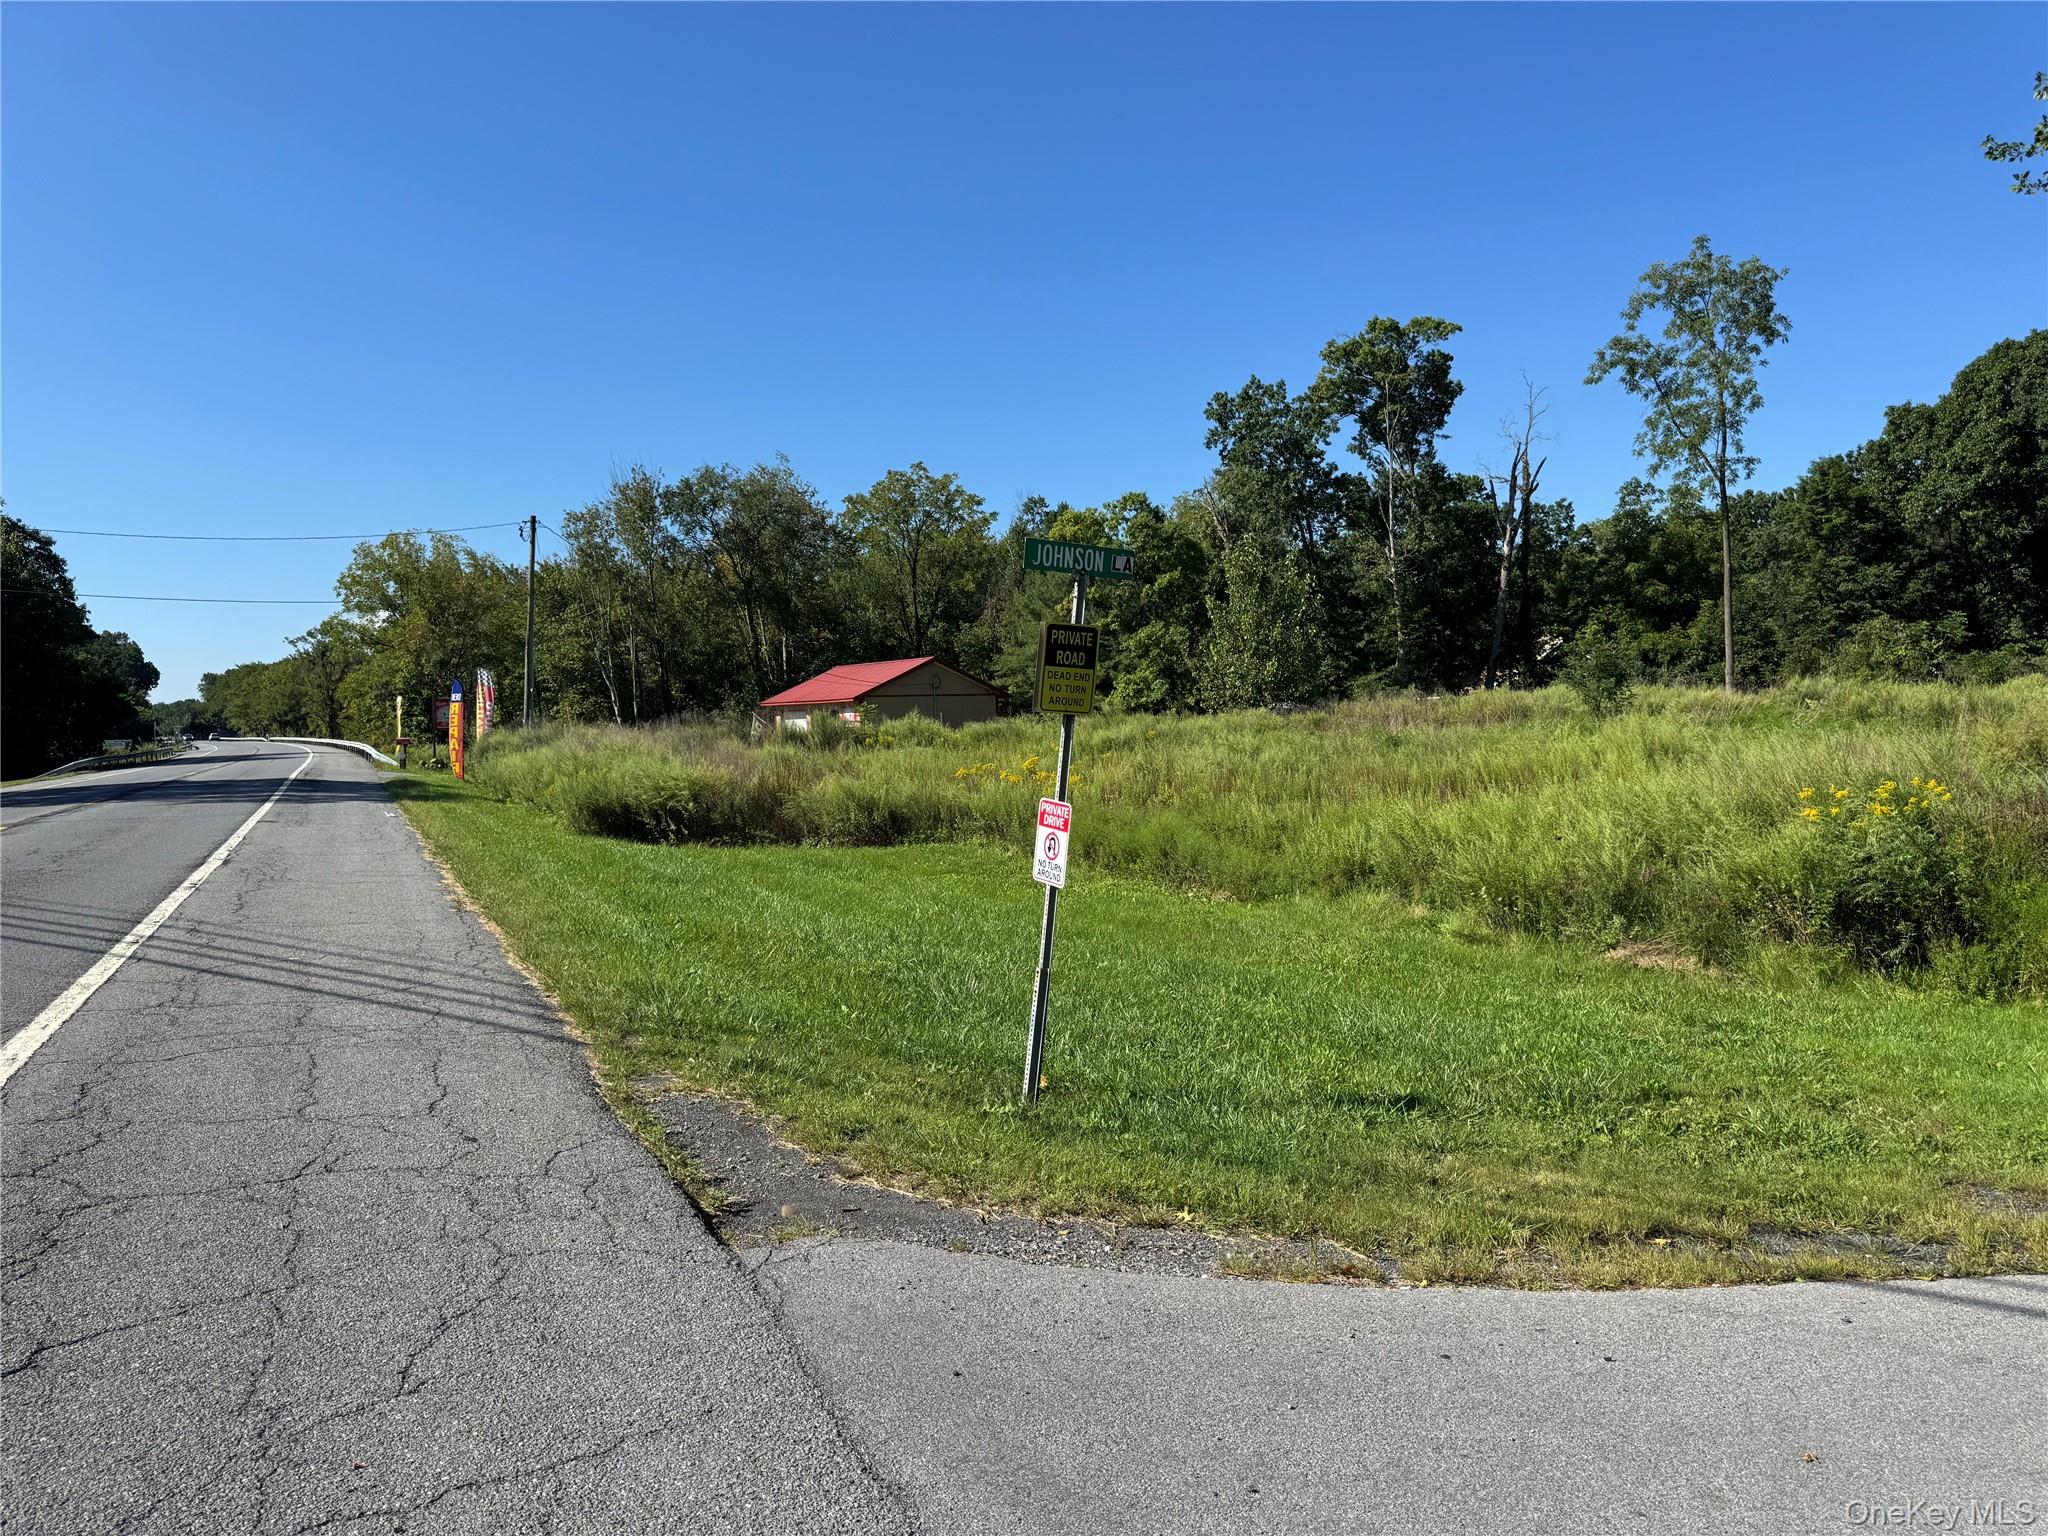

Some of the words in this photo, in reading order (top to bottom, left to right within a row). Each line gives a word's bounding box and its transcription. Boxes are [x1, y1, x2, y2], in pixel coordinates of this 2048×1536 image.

[1032, 544, 1105, 572] JOHNSON
[1111, 555, 1133, 573] LA
[1051, 629, 1093, 646] PRIVATE
[1056, 650, 1086, 666] ROAD
[1047, 670, 1071, 681] DEAD
[1073, 672, 1091, 682] END
[1048, 683, 1062, 693] NO
[1064, 684, 1087, 695] TURN
[1048, 696, 1085, 708] AROUND
[1041, 802, 1070, 818] PRIVATE
[1044, 814, 1065, 828] DRIVE
[1038, 859, 1046, 868] NO
[1048, 861, 1062, 873] TURN
[1037, 868, 1061, 882] AROUND
